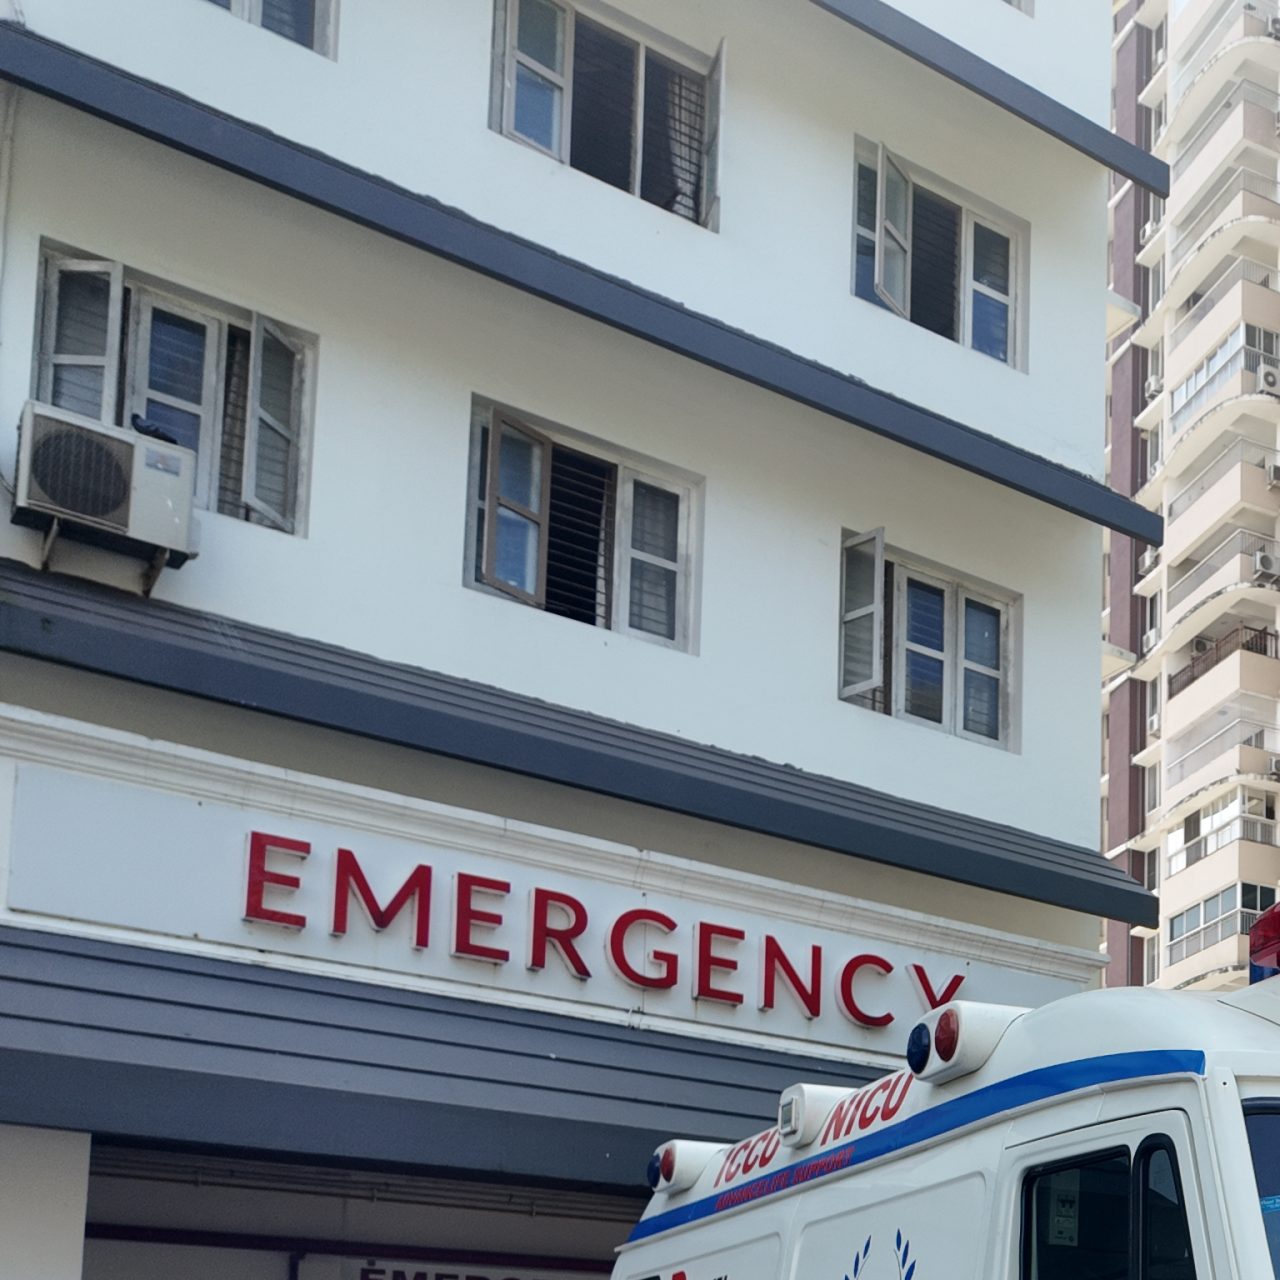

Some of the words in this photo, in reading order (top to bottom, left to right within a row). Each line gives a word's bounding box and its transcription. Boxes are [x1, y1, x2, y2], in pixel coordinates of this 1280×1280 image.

[243, 830, 966, 1029] EMERGENCY
[713, 1128, 781, 1188] ICCU
[820, 1072, 914, 1146] NICU
